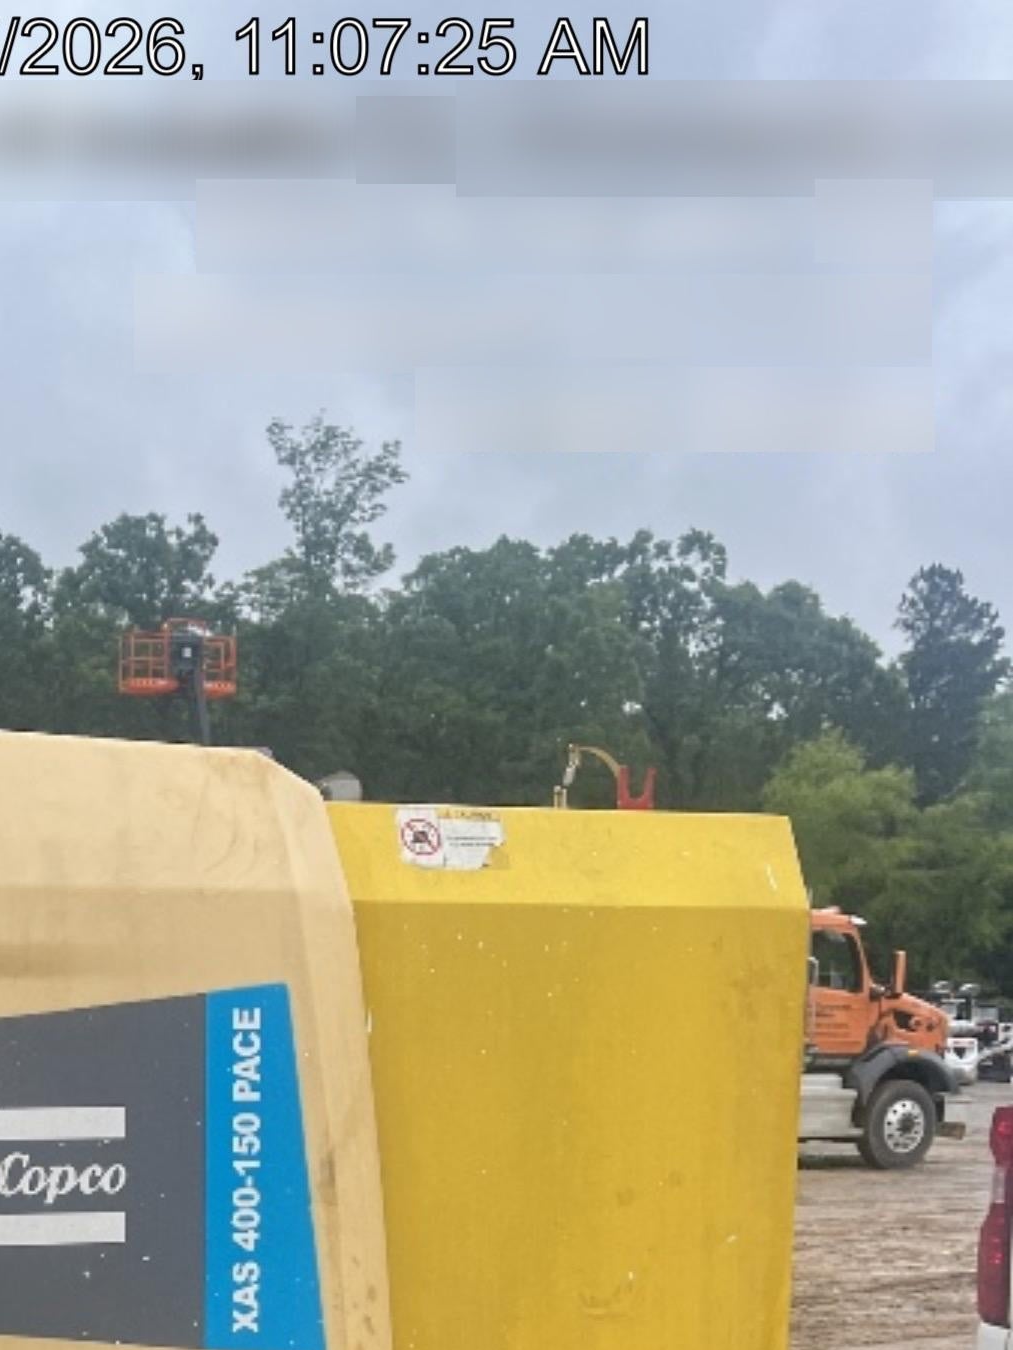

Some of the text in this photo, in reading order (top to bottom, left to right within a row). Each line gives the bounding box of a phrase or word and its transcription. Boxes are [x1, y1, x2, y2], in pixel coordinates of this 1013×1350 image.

[232, 1007, 263, 1334] XAS 400-150 PACE
